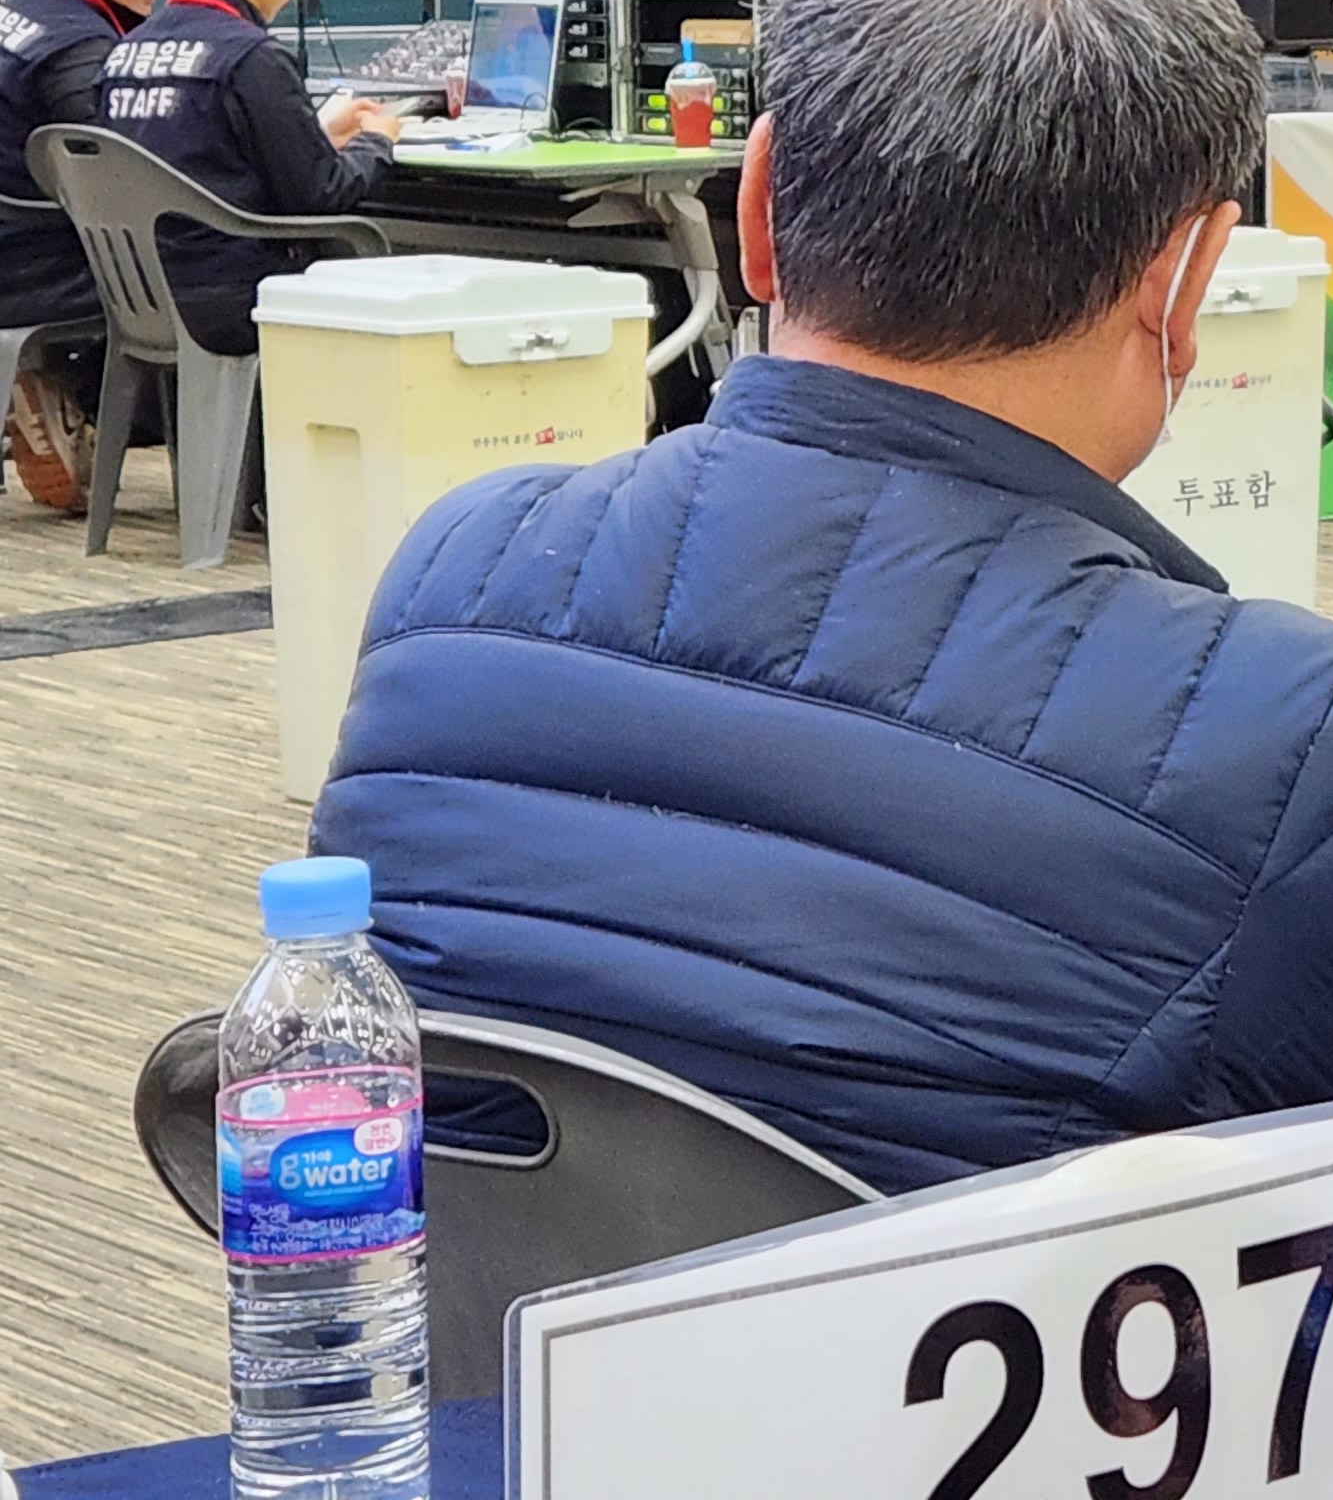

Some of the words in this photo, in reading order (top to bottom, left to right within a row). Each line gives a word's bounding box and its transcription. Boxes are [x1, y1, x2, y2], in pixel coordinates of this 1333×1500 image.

[107, 86, 176, 120] STAFF
[1173, 469, 1277, 516] 투표함
[302, 1156, 394, 1189] water
